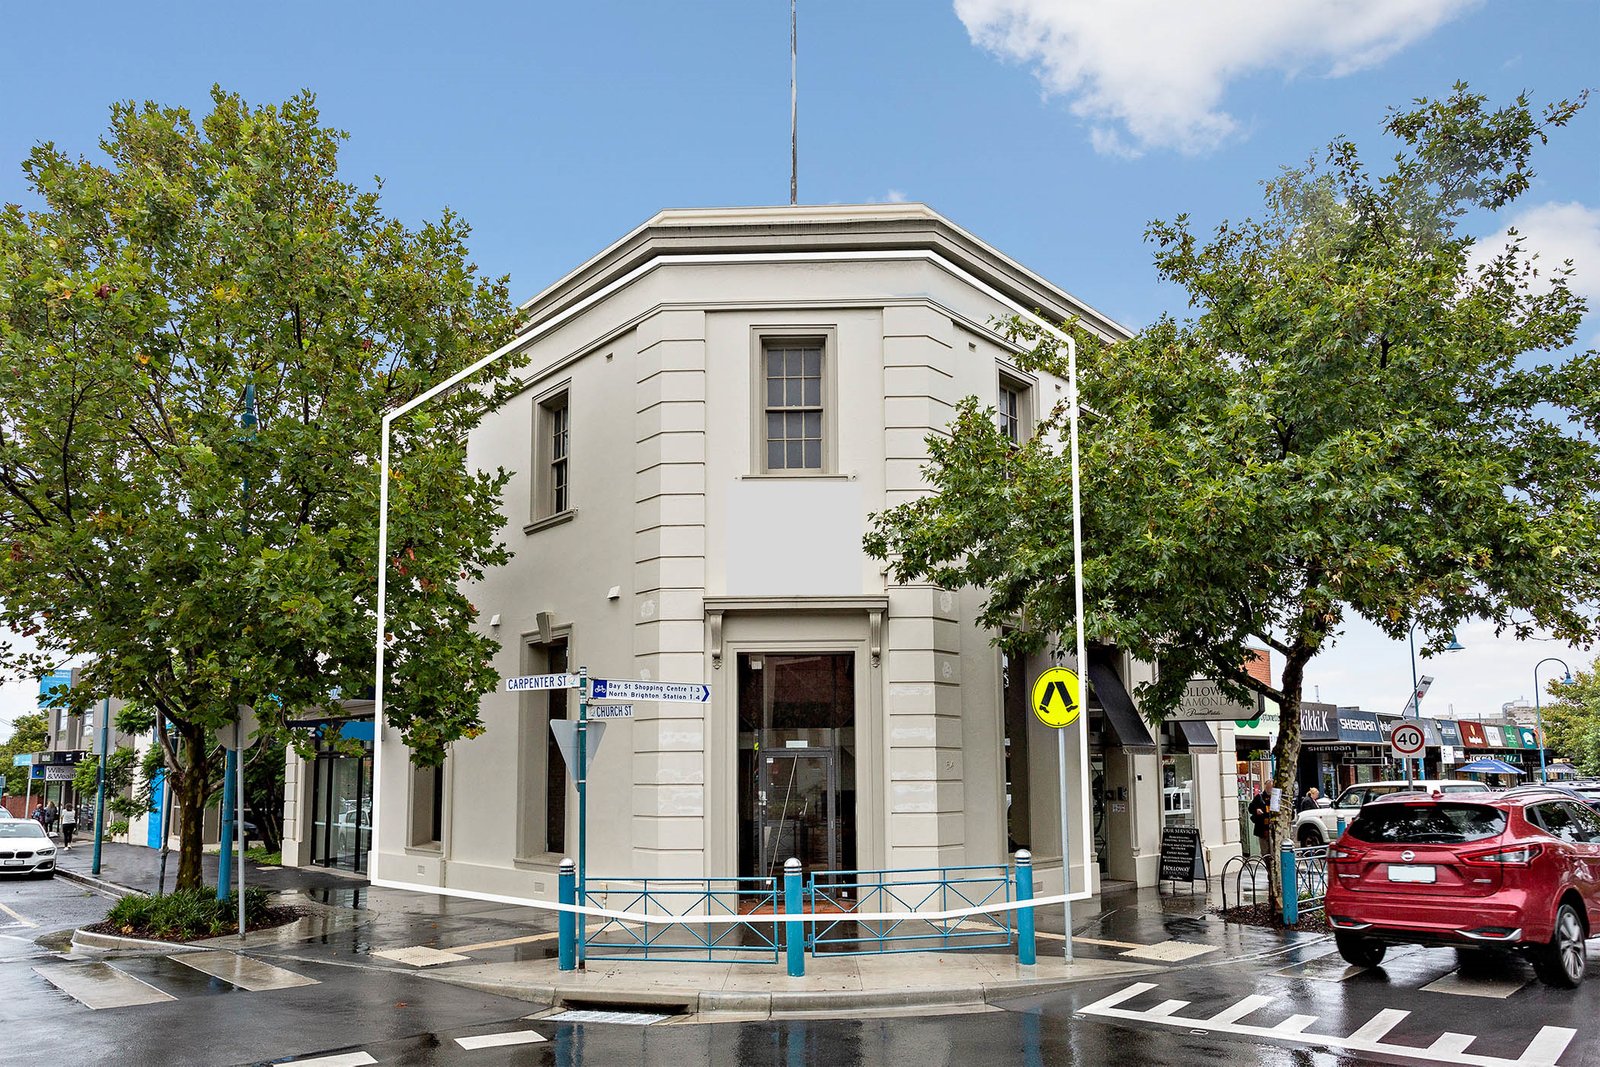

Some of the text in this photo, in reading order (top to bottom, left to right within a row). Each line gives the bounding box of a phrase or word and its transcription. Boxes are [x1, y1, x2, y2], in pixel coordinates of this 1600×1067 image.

[508, 675, 567, 690] CARPENTER ST
[634, 683, 664, 692] Shopping
[596, 705, 632, 717] CHURCH ST
[1300, 709, 1329, 732] kikki.K
[1397, 732, 1419, 745] 40
